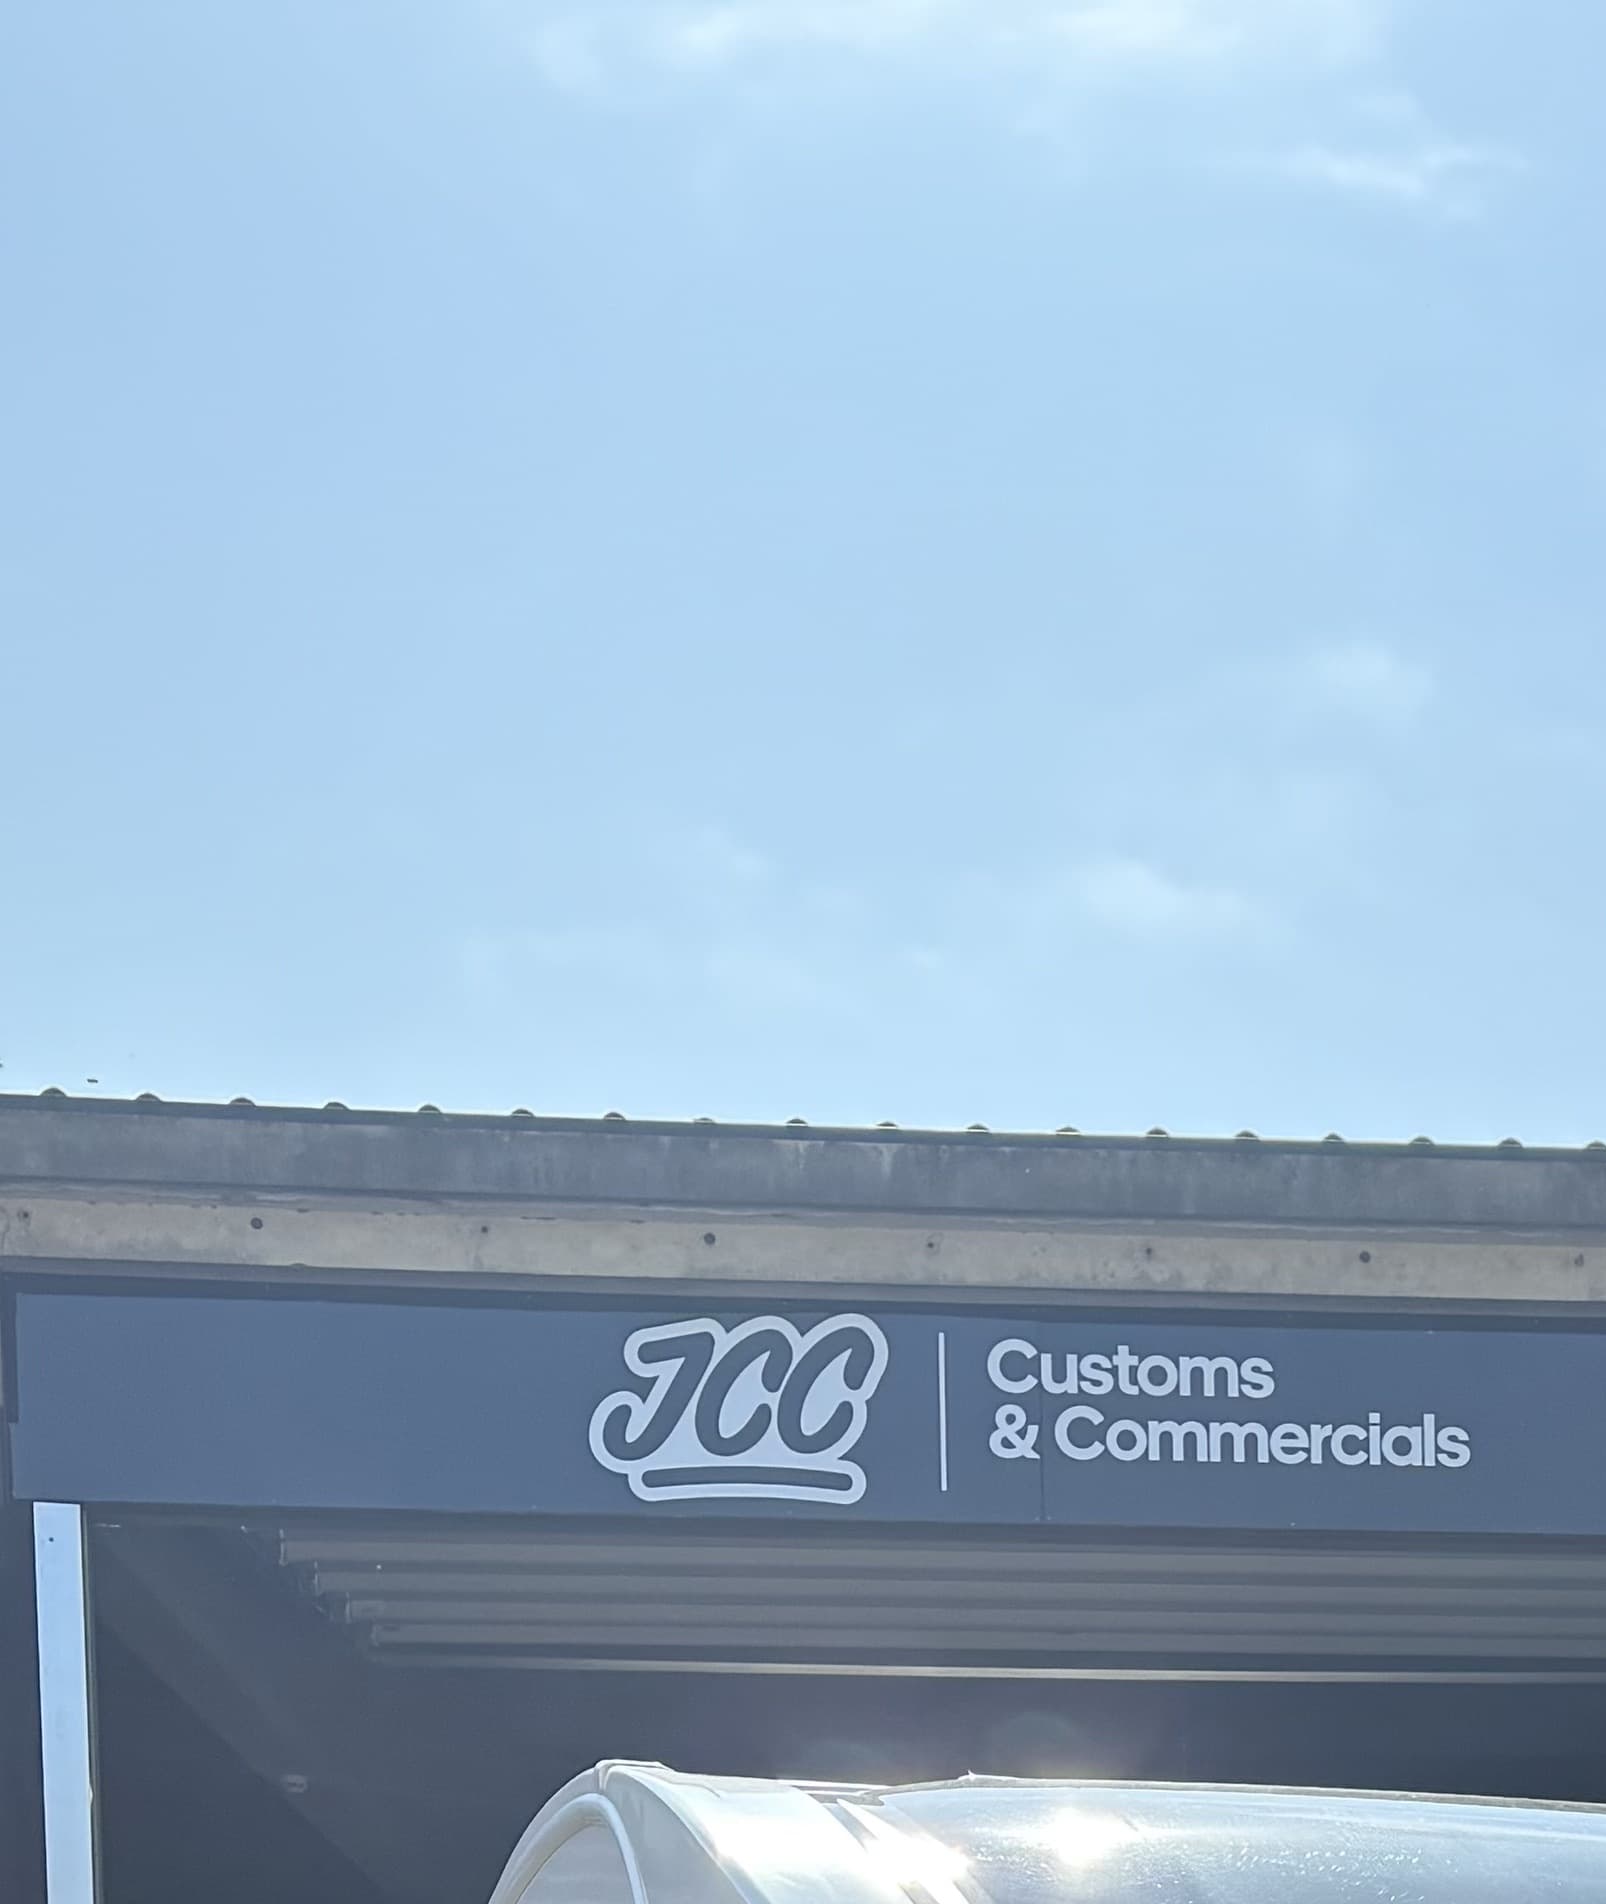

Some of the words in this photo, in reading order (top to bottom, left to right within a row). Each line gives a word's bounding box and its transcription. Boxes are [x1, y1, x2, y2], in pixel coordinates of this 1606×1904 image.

[589, 1313, 889, 1474] JCC
[987, 1338, 1275, 1398] Customs
[989, 1404, 1040, 1459] &
[1054, 1405, 1471, 1468] Commercials
